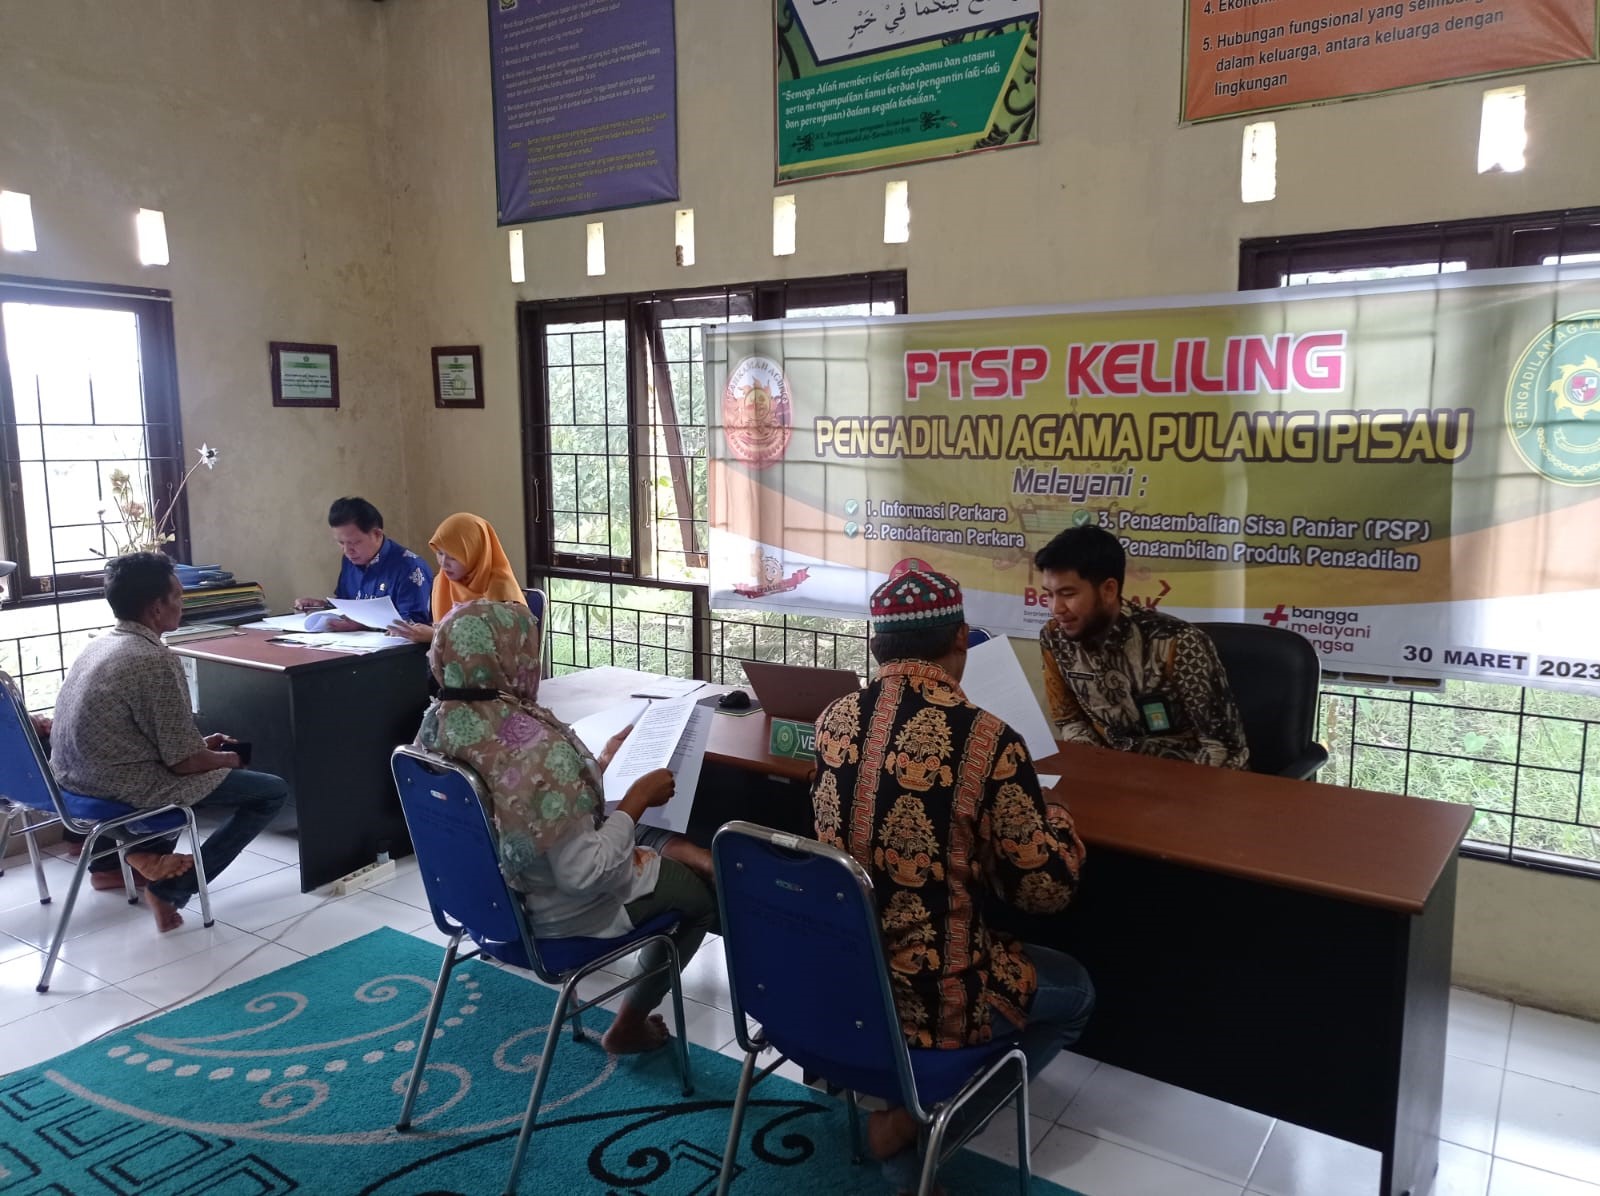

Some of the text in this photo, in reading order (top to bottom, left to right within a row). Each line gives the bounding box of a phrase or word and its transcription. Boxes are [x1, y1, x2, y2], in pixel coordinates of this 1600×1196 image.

[1202, 36, 1213, 52] 5.
[1217, 25, 1285, 49] Hubungan
[1289, 8, 1364, 36] fungsional
[1367, 3, 1404, 25] yang
[1216, 10, 1504, 72] dalam keluarga, antara keluarga dengan
[785, 61, 1001, 115] serta mengumpulkan kamu berdua (pengantin laki-laki
[816, 80, 838, 95] Allah
[838, 74, 872, 90] memberi
[872, 67, 900, 83] berkah
[900, 62, 943, 81] kepadamu
[944, 57, 961, 68] dan
[962, 49, 996, 64] atasmu
[1214, 73, 1288, 97] lingkungan
[785, 119, 800, 129] dan
[799, 110, 846, 131] perempuan)
[846, 104, 871, 118] dalam
[871, 98, 898, 116] segala
[905, 330, 1348, 401] PTSP KELILING
[1515, 320, 1600, 429] PENGADILAN AGAM
[815, 413, 1003, 460] PENGADILAN
[1007, 412, 1143, 462] AGAMA
[1148, 409, 1319, 462] PULANG
[1324, 407, 1475, 463] PISAU
[1011, 466, 1135, 503] Melayani
[865, 500, 1008, 522] 1. Informasi Perkara
[1098, 511, 1431, 542] 3. Pengembalian Sisa Panjar (PSP)
[864, 524, 1025, 548] 2. Pendaftaran Perkara
[1118, 537, 1419, 571] Pengambilan Produk Pengadilan
[1291, 622, 1371, 639] melayani
[1292, 605, 1359, 625] bangga
[1310, 639, 1354, 654] ngsa
[1402, 644, 1600, 680] 30 MARET 2023
